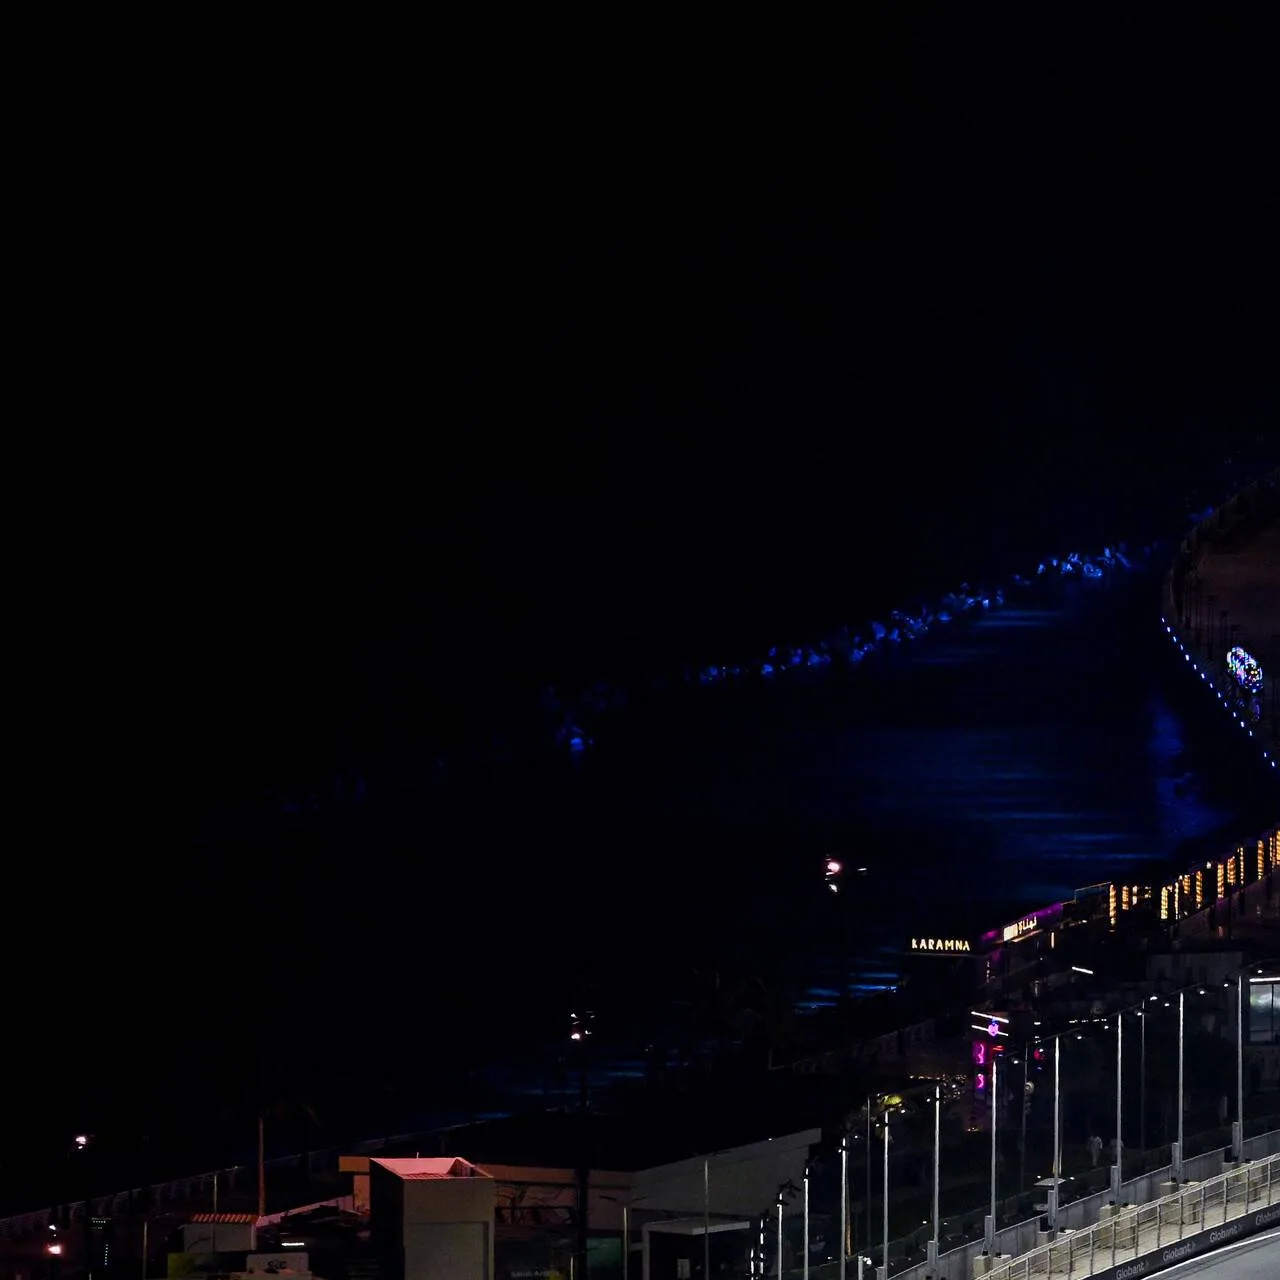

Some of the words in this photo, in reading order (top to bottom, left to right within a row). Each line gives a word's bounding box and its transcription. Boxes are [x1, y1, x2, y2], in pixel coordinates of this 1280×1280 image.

[911, 938, 971, 952] KARAMNA
[1208, 1225, 1239, 1244] Globant
[1162, 1243, 1192, 1262] Globant
[1116, 1261, 1146, 1280] Globant
